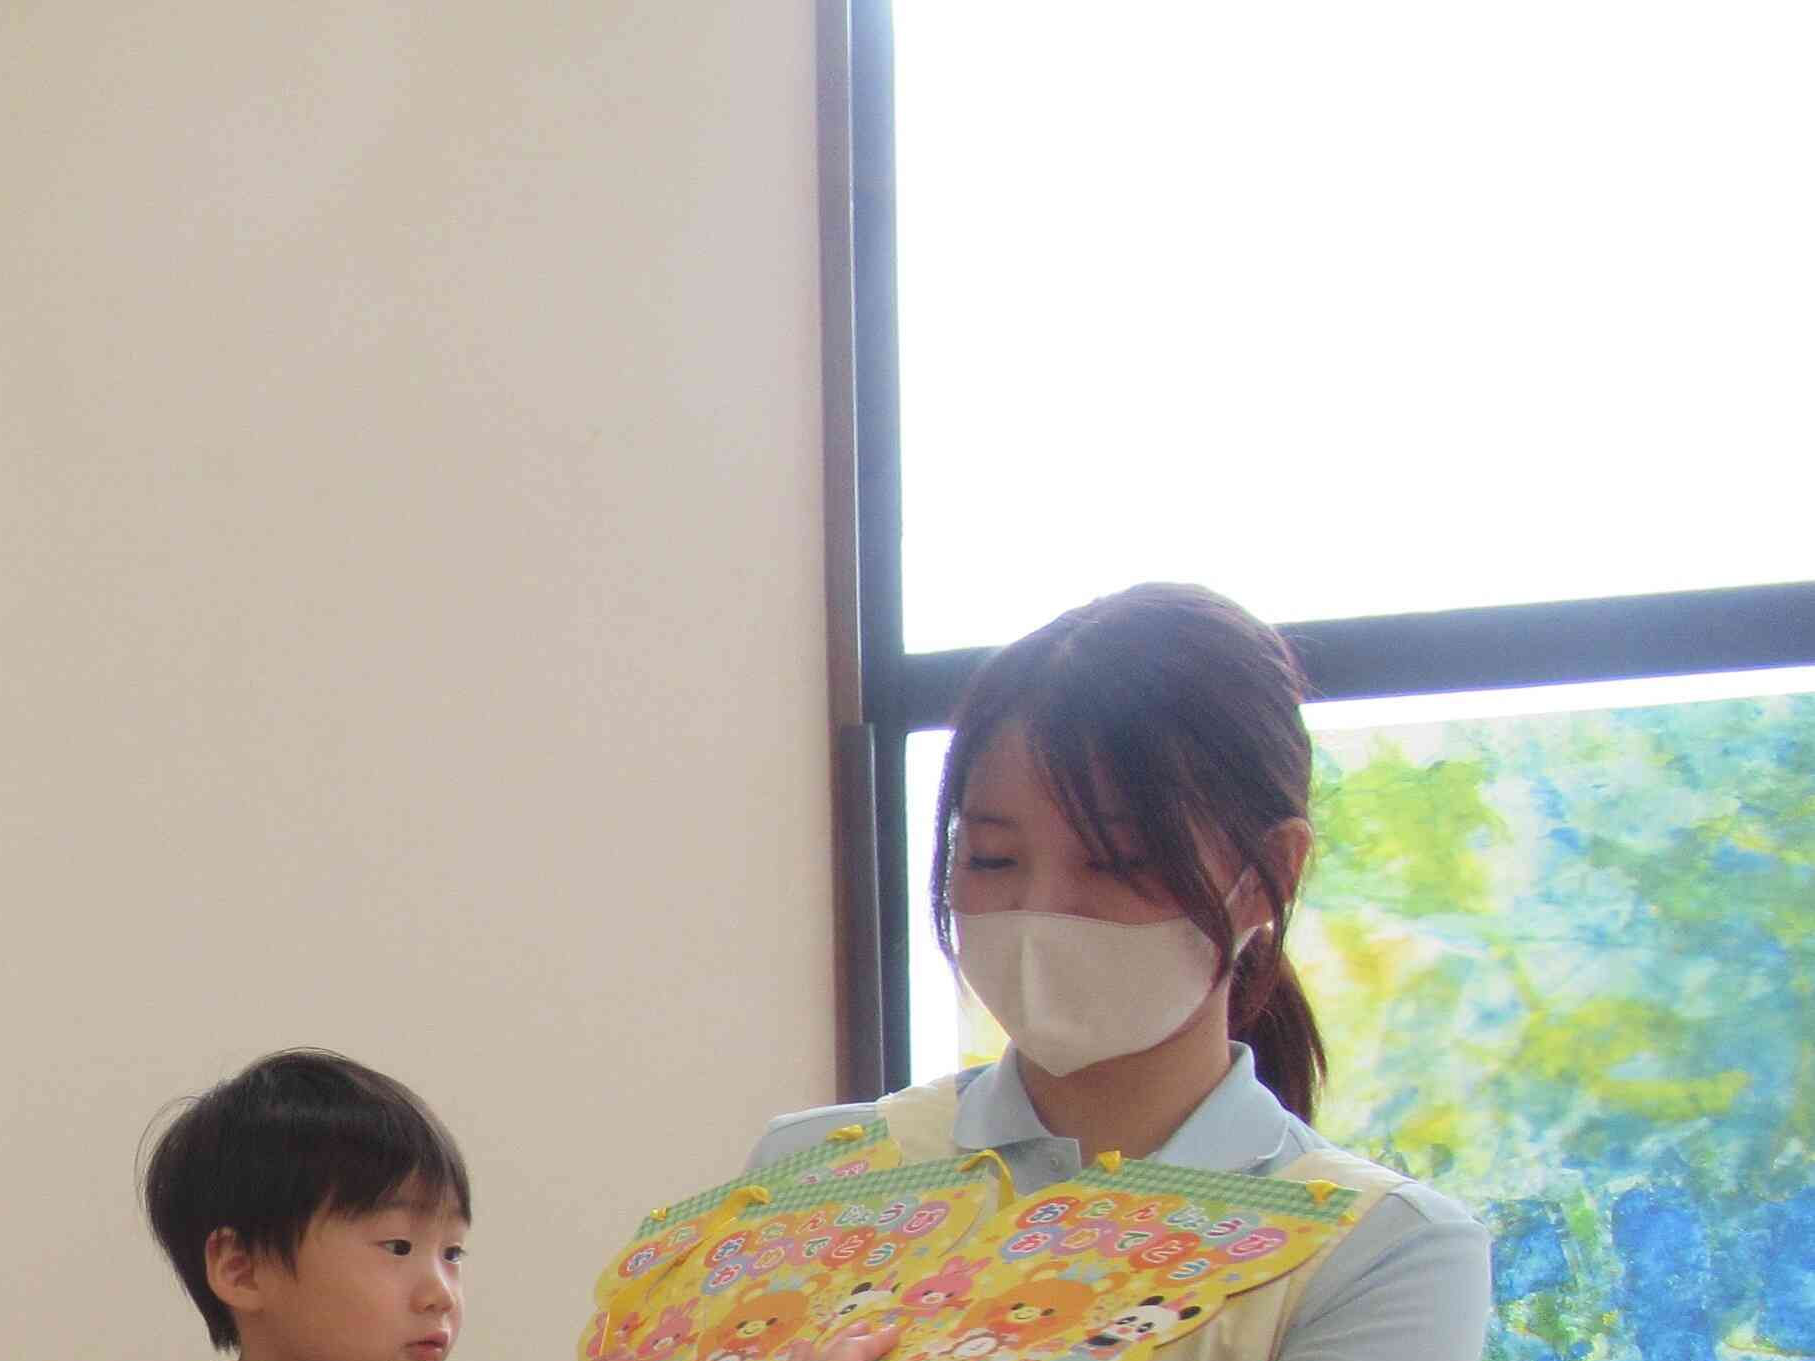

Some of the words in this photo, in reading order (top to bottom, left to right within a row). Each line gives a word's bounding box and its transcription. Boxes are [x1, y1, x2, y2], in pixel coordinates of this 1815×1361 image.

[712, 1202, 946, 1261] おたんじょうび
[1006, 1229, 1211, 1280] おめでとう
[1024, 1198, 1282, 1257] おたんじょうび
[707, 1233, 898, 1289] おめでとう
